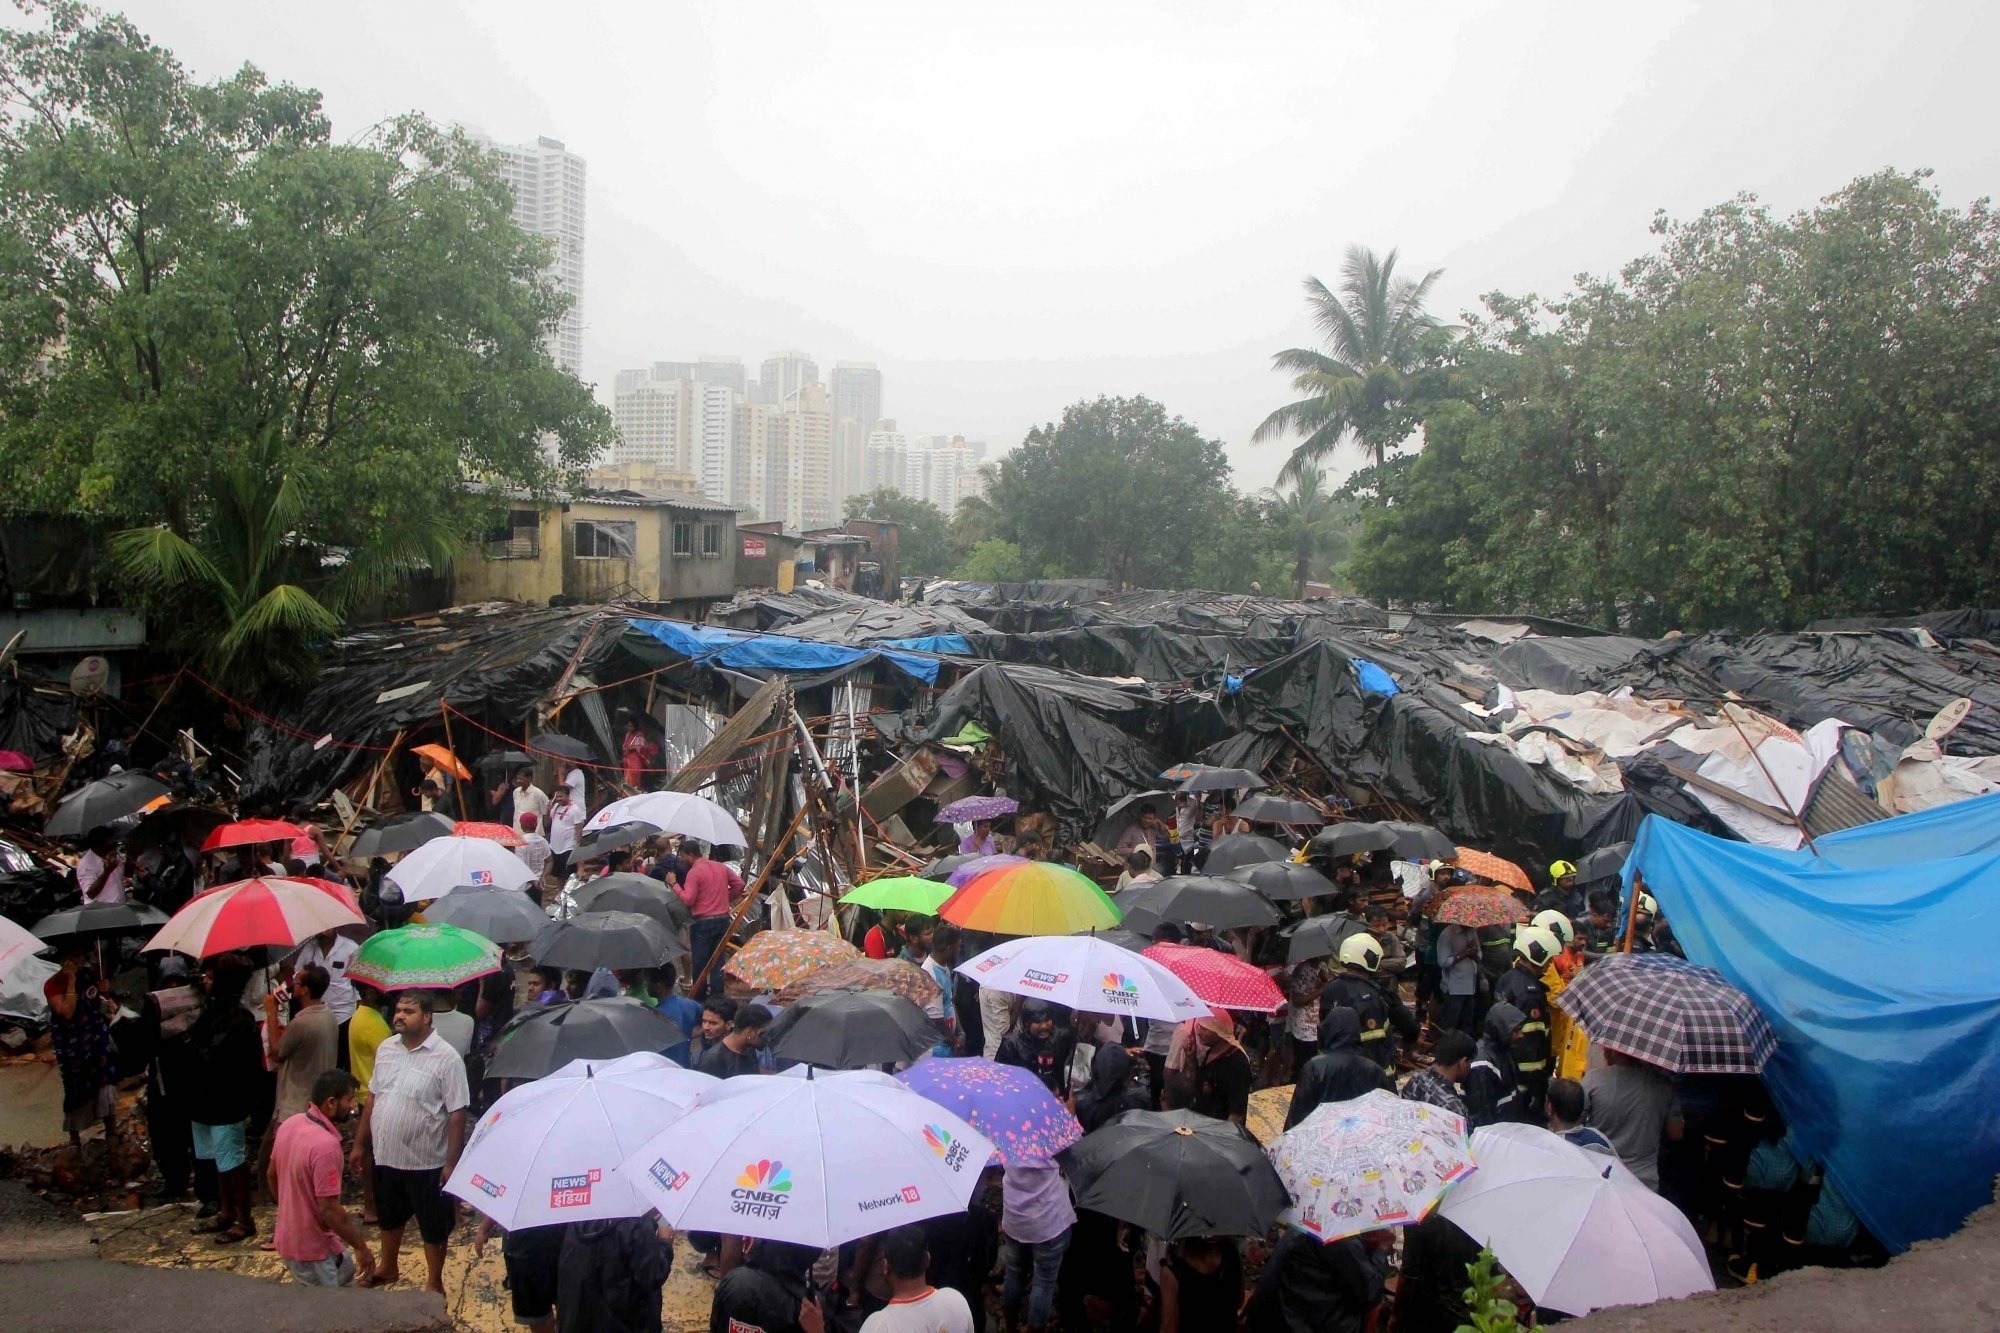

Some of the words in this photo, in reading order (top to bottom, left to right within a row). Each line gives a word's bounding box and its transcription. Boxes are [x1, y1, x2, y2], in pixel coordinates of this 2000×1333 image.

[1026, 971, 1055, 982] NEWS
[1102, 988, 1140, 999] CNBC
[944, 1139, 961, 1166] CNBC
[553, 1177, 587, 1189] NEWS
[589, 1171, 600, 1182] 18
[652, 1161, 677, 1186] NEWS
[676, 1174, 687, 1188] 18
[553, 1190, 589, 1207] इंडिया
[731, 1188, 790, 1205] CNBC
[858, 1194, 903, 1212] Network
[903, 1189, 919, 1201] 18
[731, 1200, 782, 1220] आवाज़
